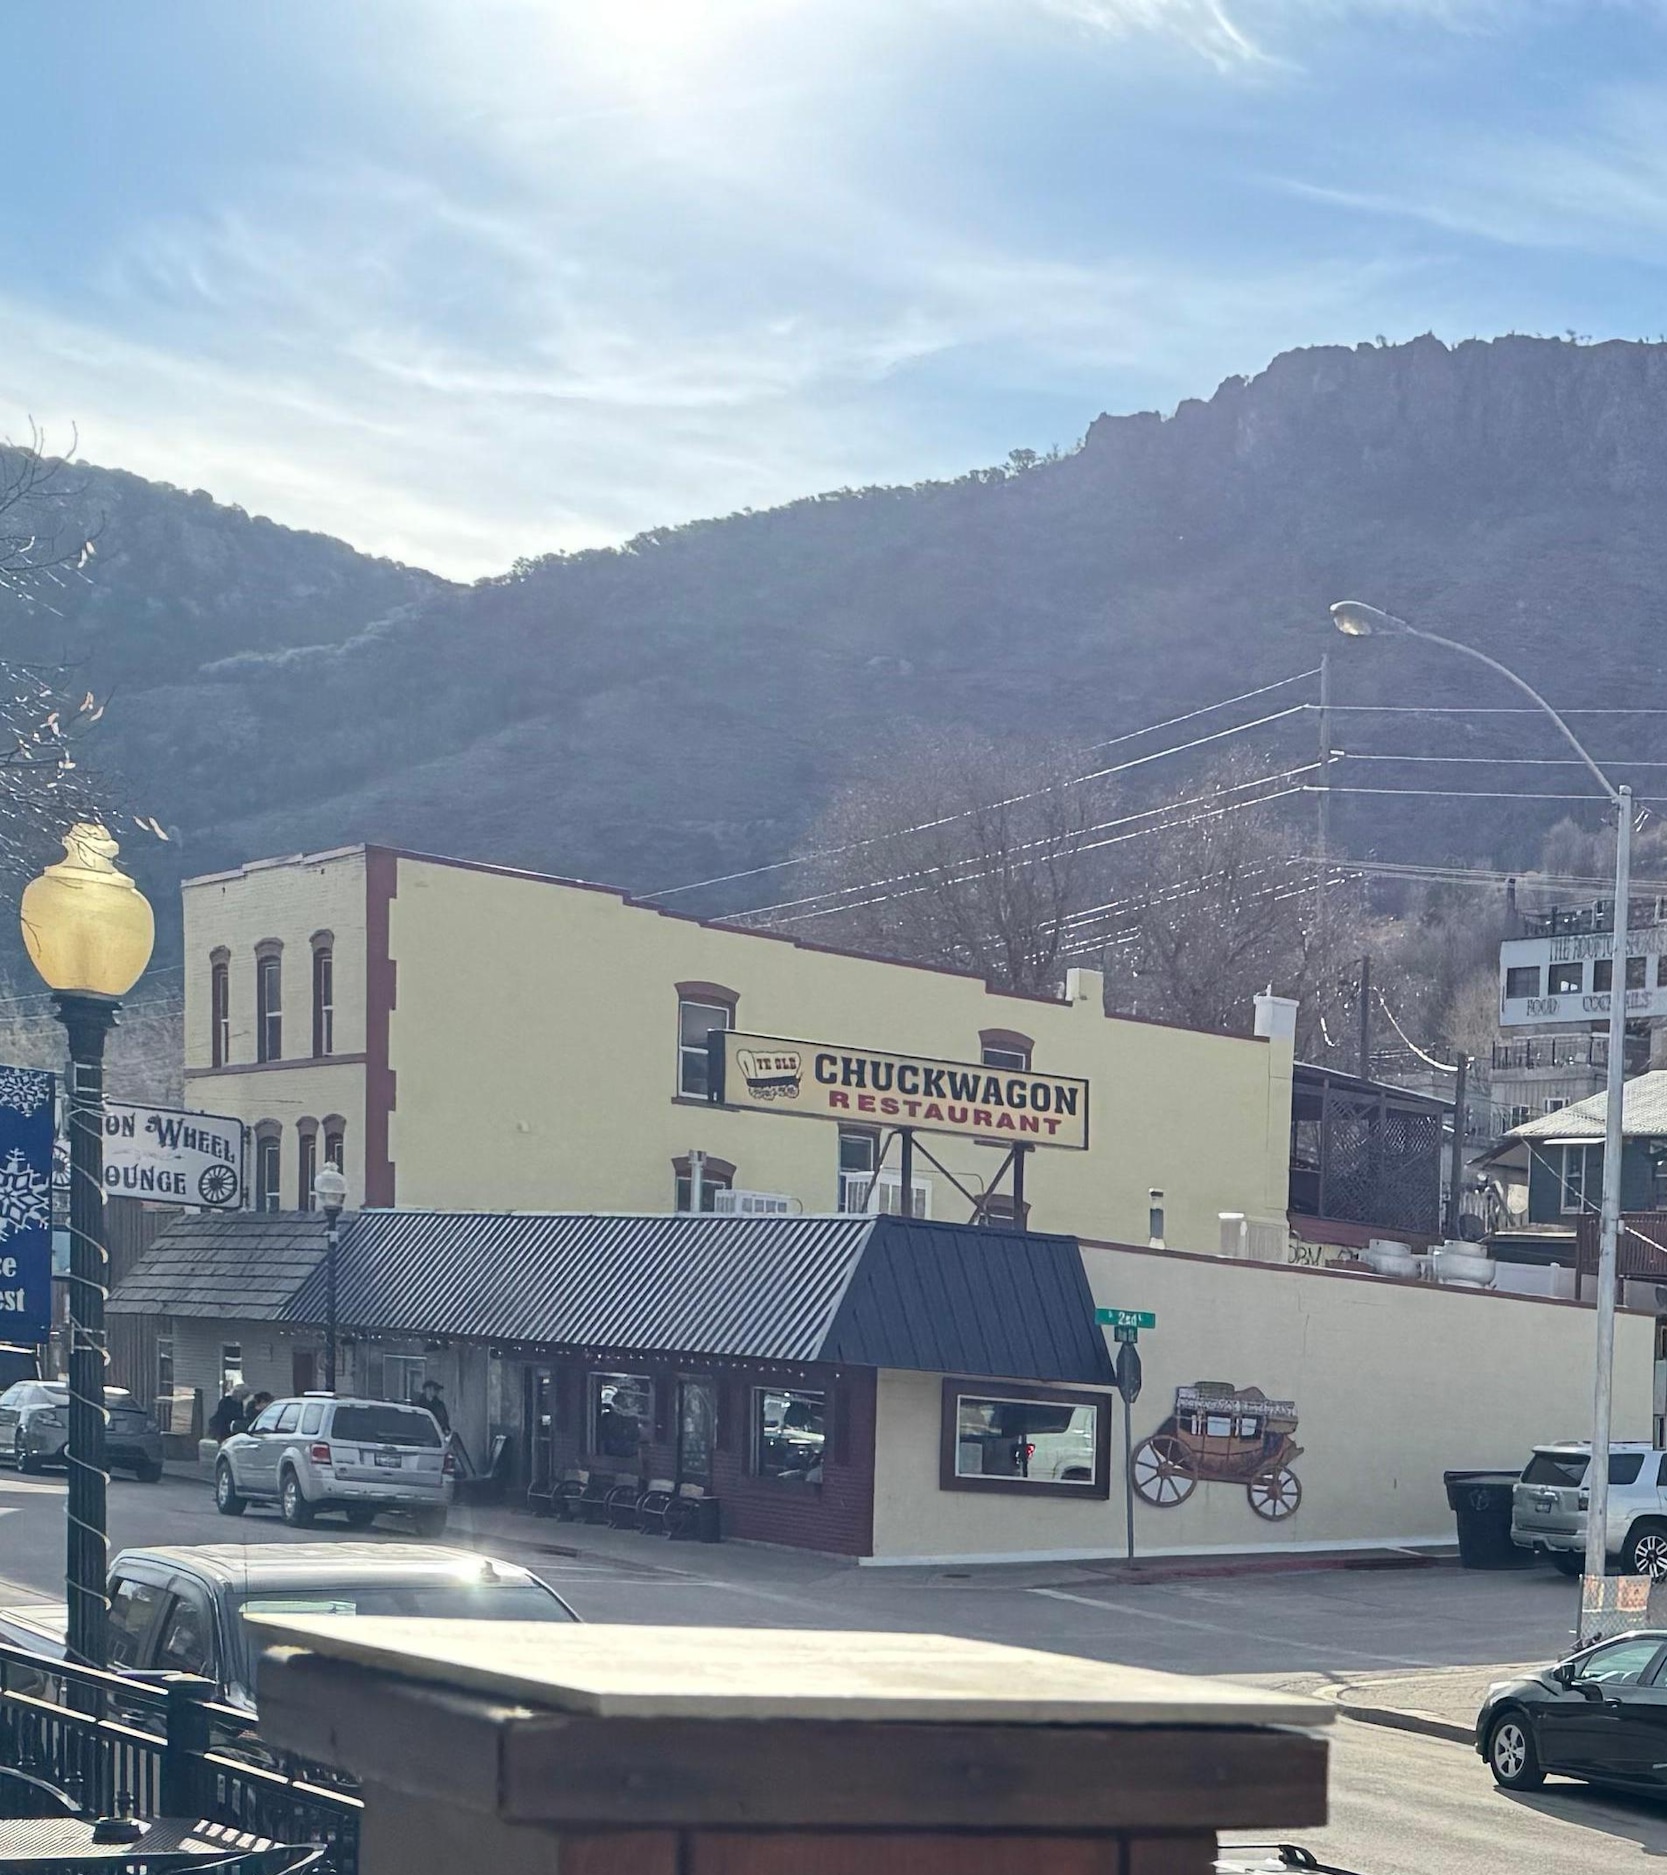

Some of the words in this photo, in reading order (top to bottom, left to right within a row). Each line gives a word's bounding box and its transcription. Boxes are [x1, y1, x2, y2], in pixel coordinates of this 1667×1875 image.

[815, 1053, 1079, 1116] CHUCKWAGON
[828, 1090, 1062, 1135] RESTAURANT
[105, 1112, 136, 1138] ON
[145, 1113, 236, 1164] WHEEL
[105, 1164, 187, 1195] OUNGE
